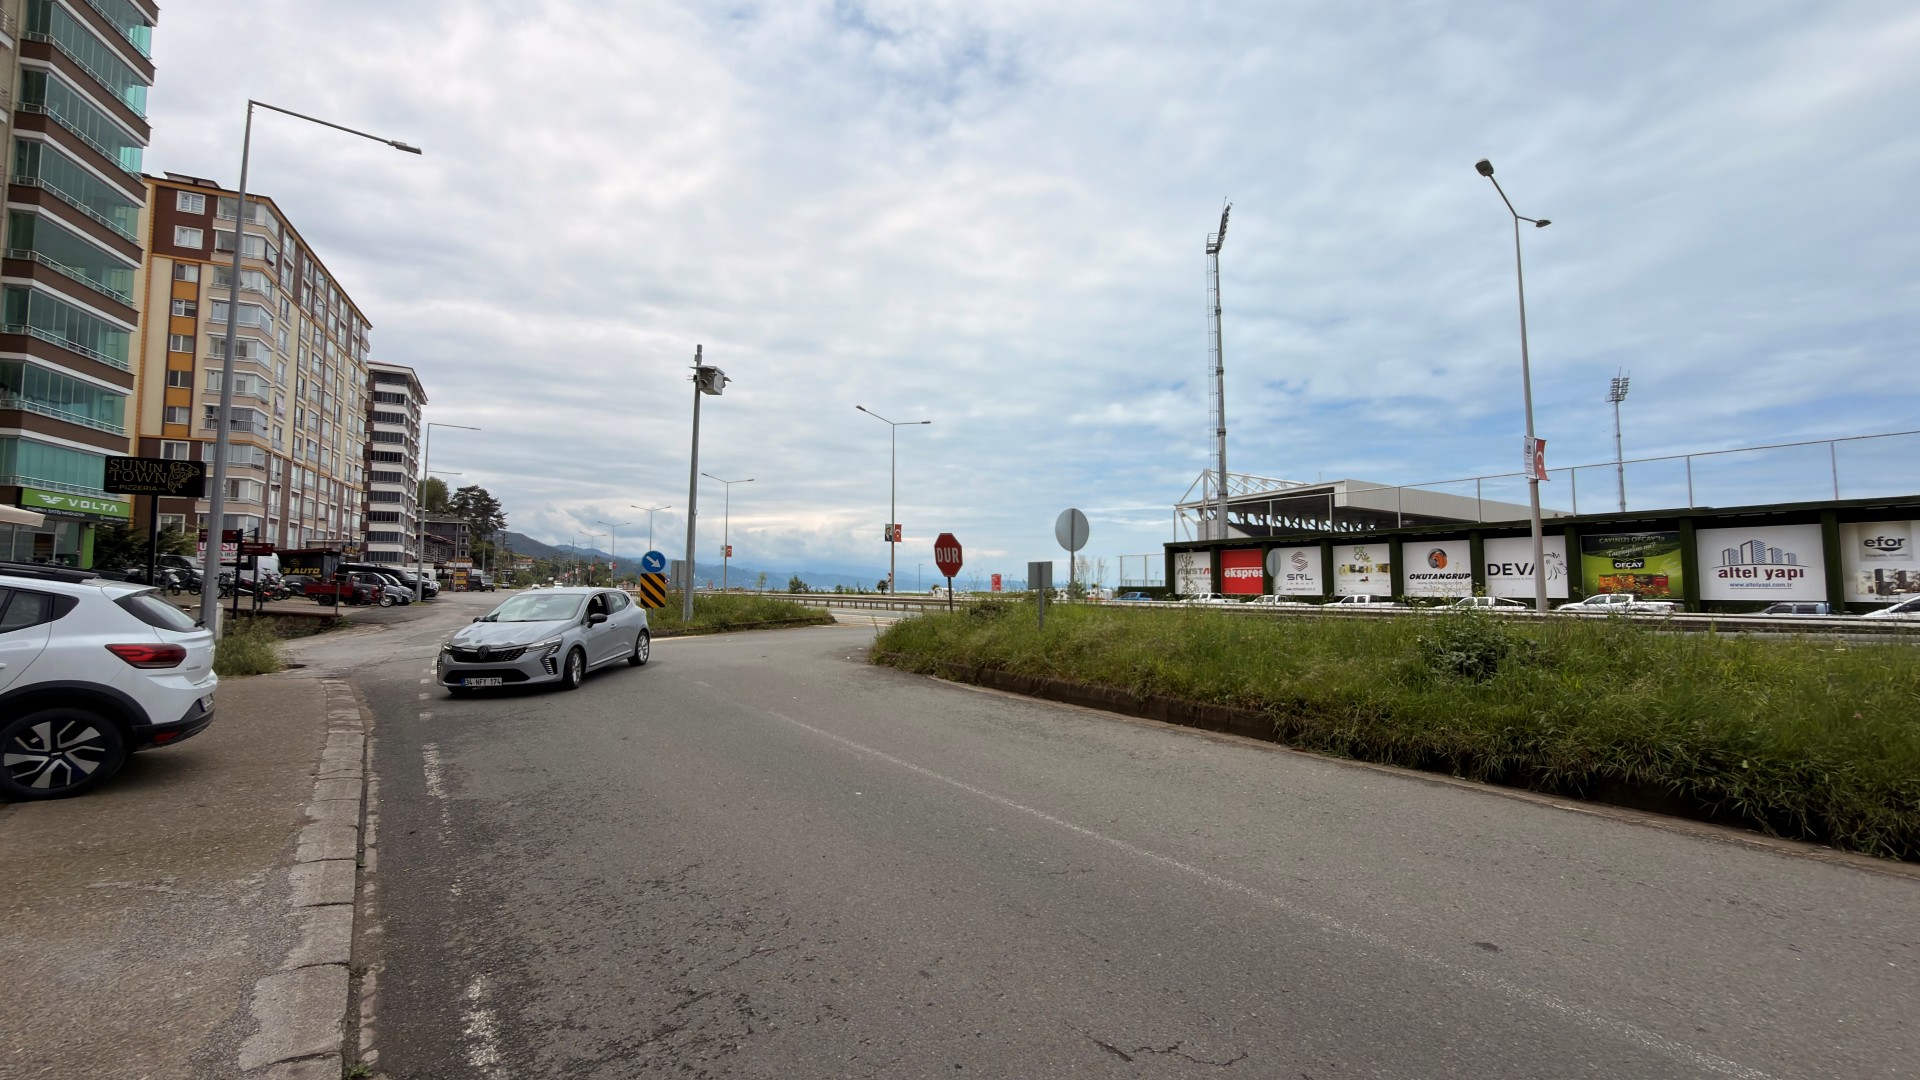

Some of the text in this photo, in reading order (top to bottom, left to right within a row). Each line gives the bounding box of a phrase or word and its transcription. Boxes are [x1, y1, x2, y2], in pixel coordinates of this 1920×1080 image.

[110, 459, 148, 472] SUN
[108, 470, 167, 484] TOWN
[68, 499, 118, 512] VOLTA
[1863, 536, 1906, 547] efor
[936, 547, 960, 563] DUR
[1224, 567, 1263, 579] ekspres
[1286, 573, 1314, 581] SRL
[1718, 567, 1804, 580] altel yapı
